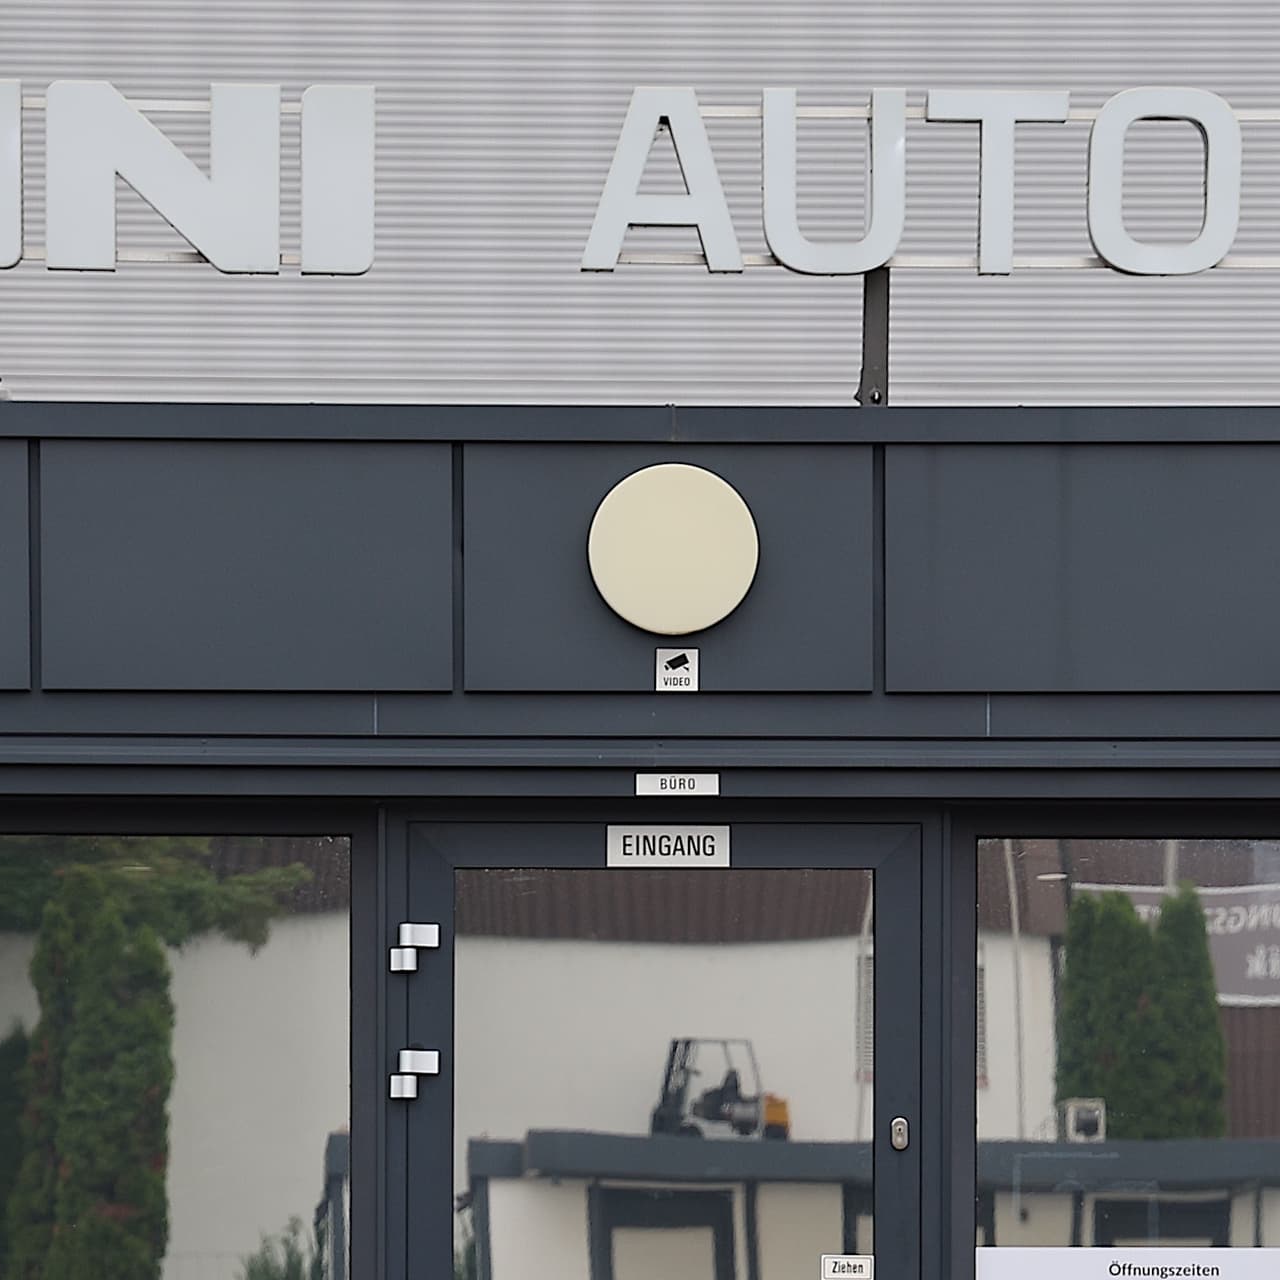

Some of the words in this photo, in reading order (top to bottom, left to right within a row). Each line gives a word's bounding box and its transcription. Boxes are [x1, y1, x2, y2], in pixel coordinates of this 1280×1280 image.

[580, 84, 1244, 277] AUTO
[663, 676, 691, 687] VIDEO
[659, 776, 696, 791] BÜRO
[622, 834, 716, 857] EINGANG
[832, 1260, 864, 1273] Ziehen
[1108, 1260, 1220, 1279] Öffnungszeiten
